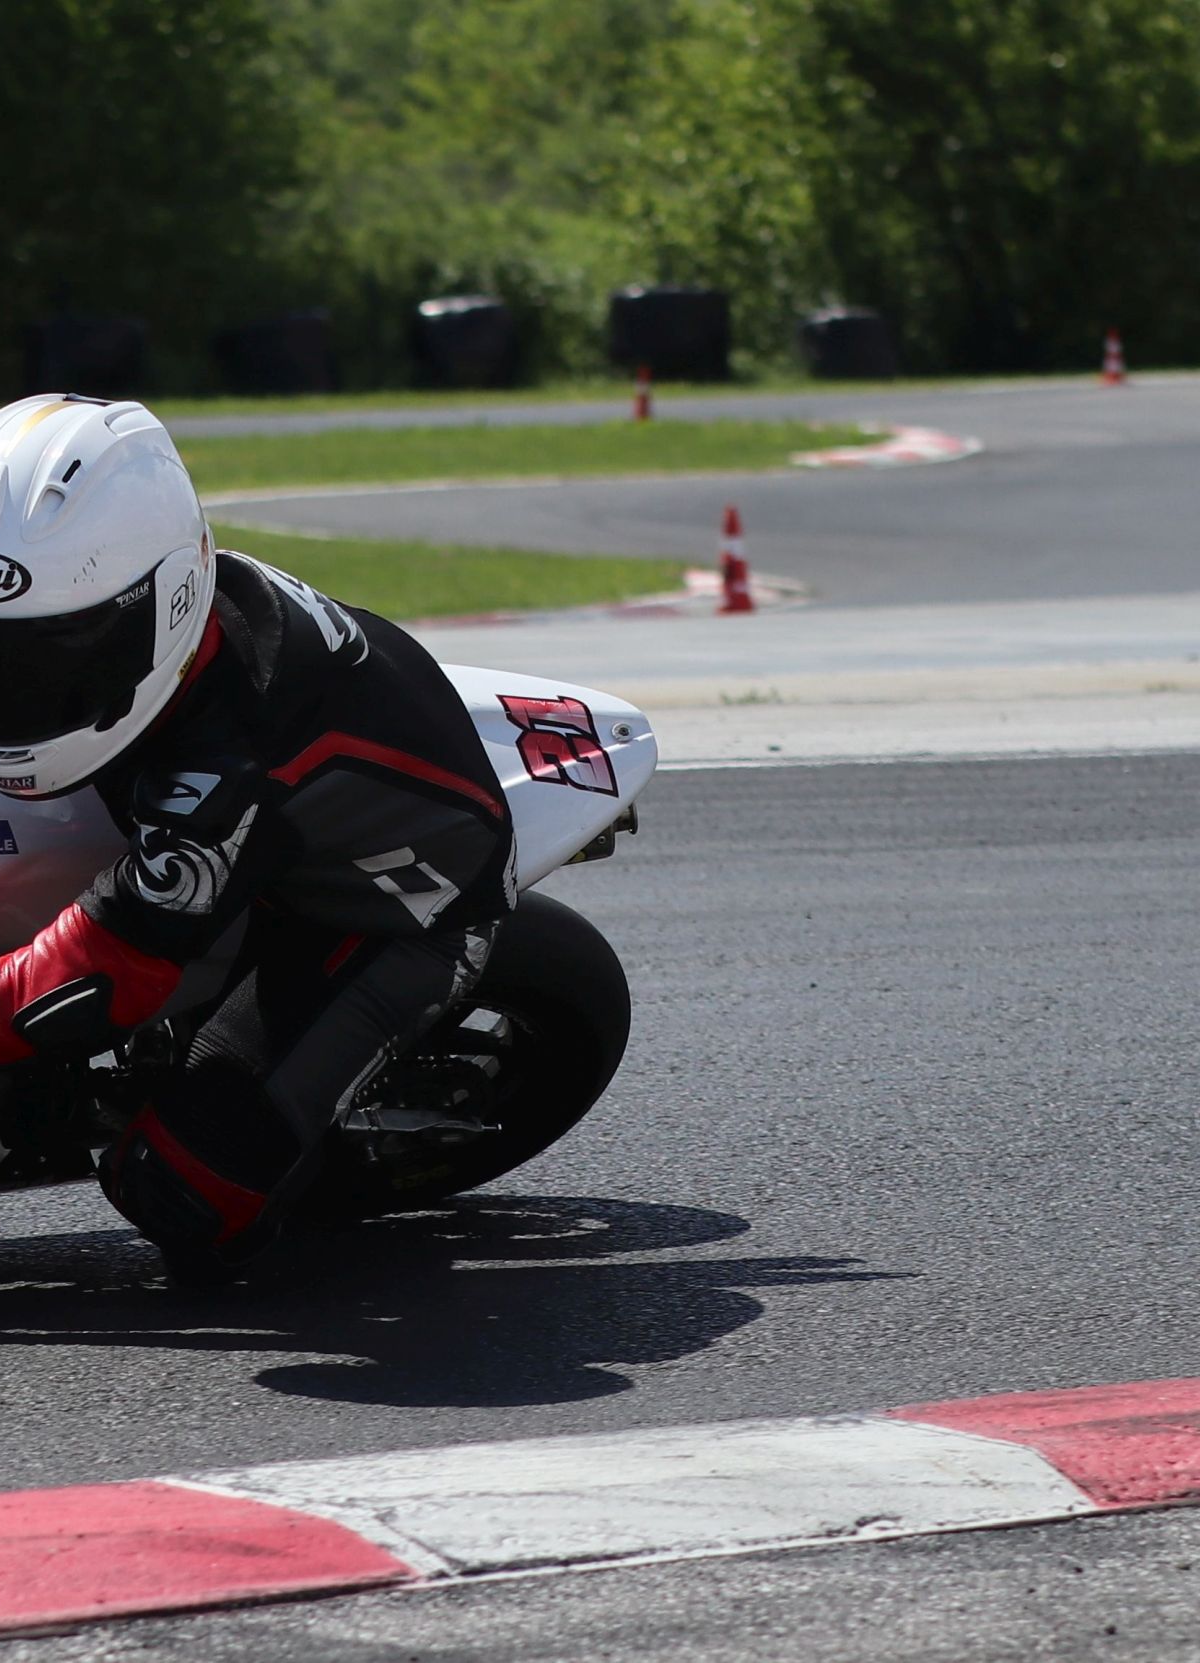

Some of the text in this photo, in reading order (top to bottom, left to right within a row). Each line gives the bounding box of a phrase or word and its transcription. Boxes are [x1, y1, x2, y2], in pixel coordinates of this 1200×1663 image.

[118, 582, 150, 606] PINTAR
[170, 569, 195, 630] 21
[496, 694, 618, 797] 21
